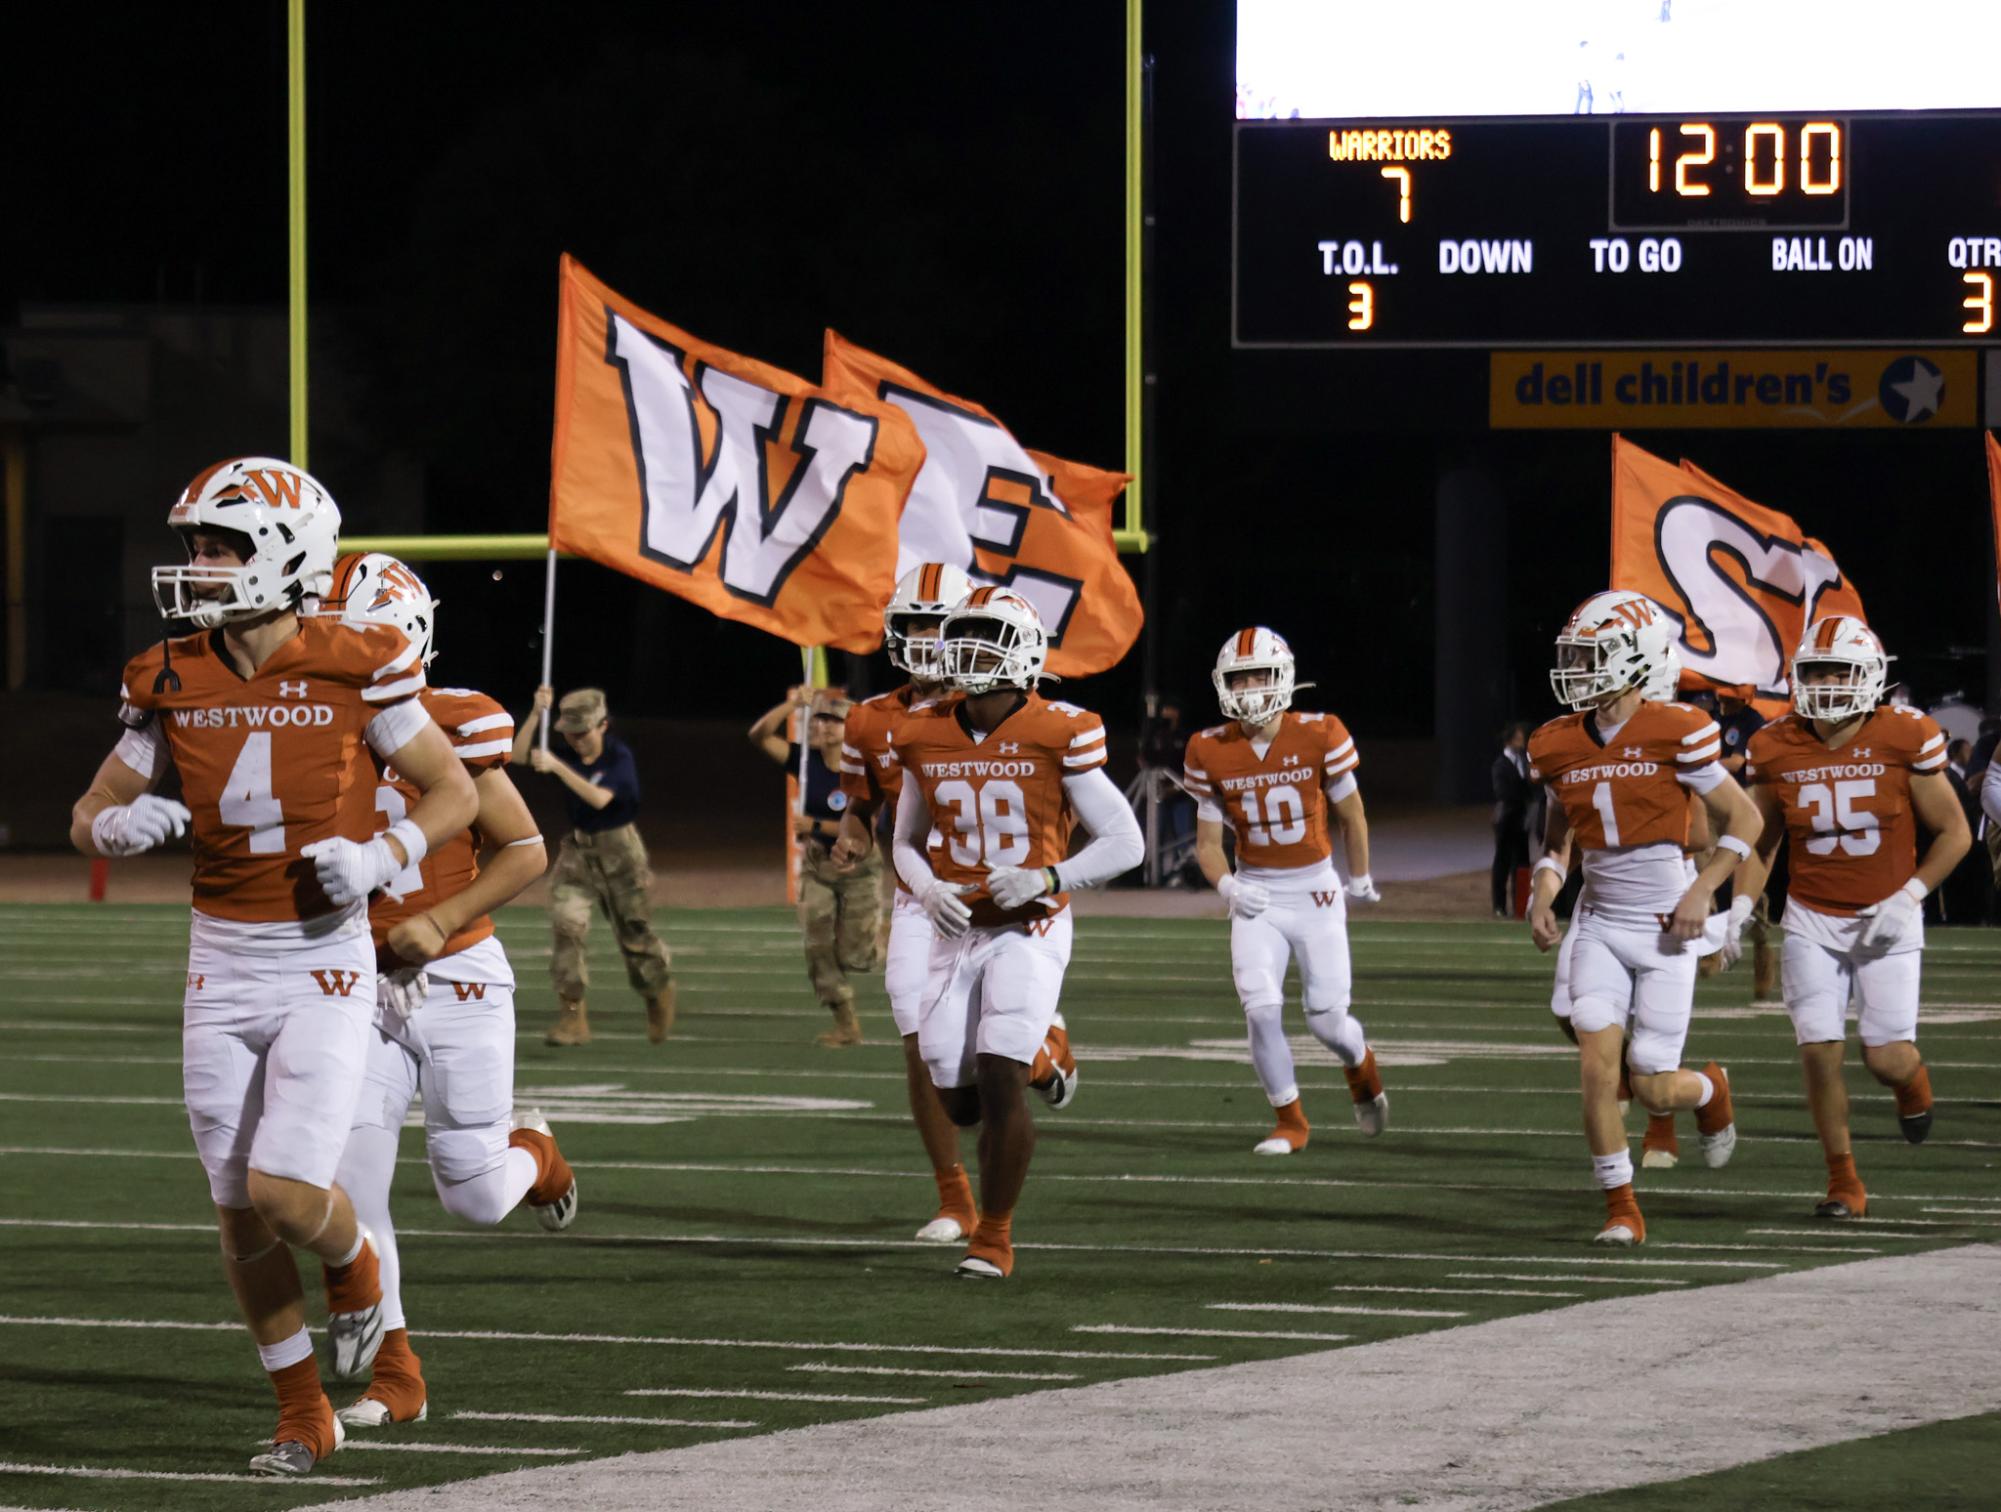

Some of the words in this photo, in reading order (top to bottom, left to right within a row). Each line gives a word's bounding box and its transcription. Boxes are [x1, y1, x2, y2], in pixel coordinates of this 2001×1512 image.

[1329, 130, 1451, 160] WARRIORS
[1381, 166, 1410, 223] 7
[1317, 240, 1399, 275] T.O.L.
[1439, 239, 1532, 274] DOWN
[1589, 239, 1631, 273] TO
[1638, 238, 1682, 273] GO
[1772, 238, 1832, 271] BALL
[1838, 237, 1873, 271] ON
[1948, 237, 2001, 269] QTR
[1348, 282, 1373, 330] 3
[1962, 272, 1992, 333] 3
[1515, 362, 1603, 406] dell
[1614, 362, 1851, 406] children's
[603, 305, 879, 609] W
[242, 469, 302, 510] W
[1611, 598, 1653, 630] W
[171, 704, 333, 729] WESTWOOD
[921, 761, 1036, 779] WESTWOOD
[1221, 767, 1313, 792] WESTWOOD
[1781, 763, 1885, 784] WESTWOOD
[218, 731, 287, 855] 4
[933, 780, 1031, 868] 38
[1240, 785, 1306, 846] 10
[1592, 782, 1621, 848] 1
[1797, 778, 1882, 857] 35
[1310, 890, 1337, 908] W
[309, 969, 360, 997] W
